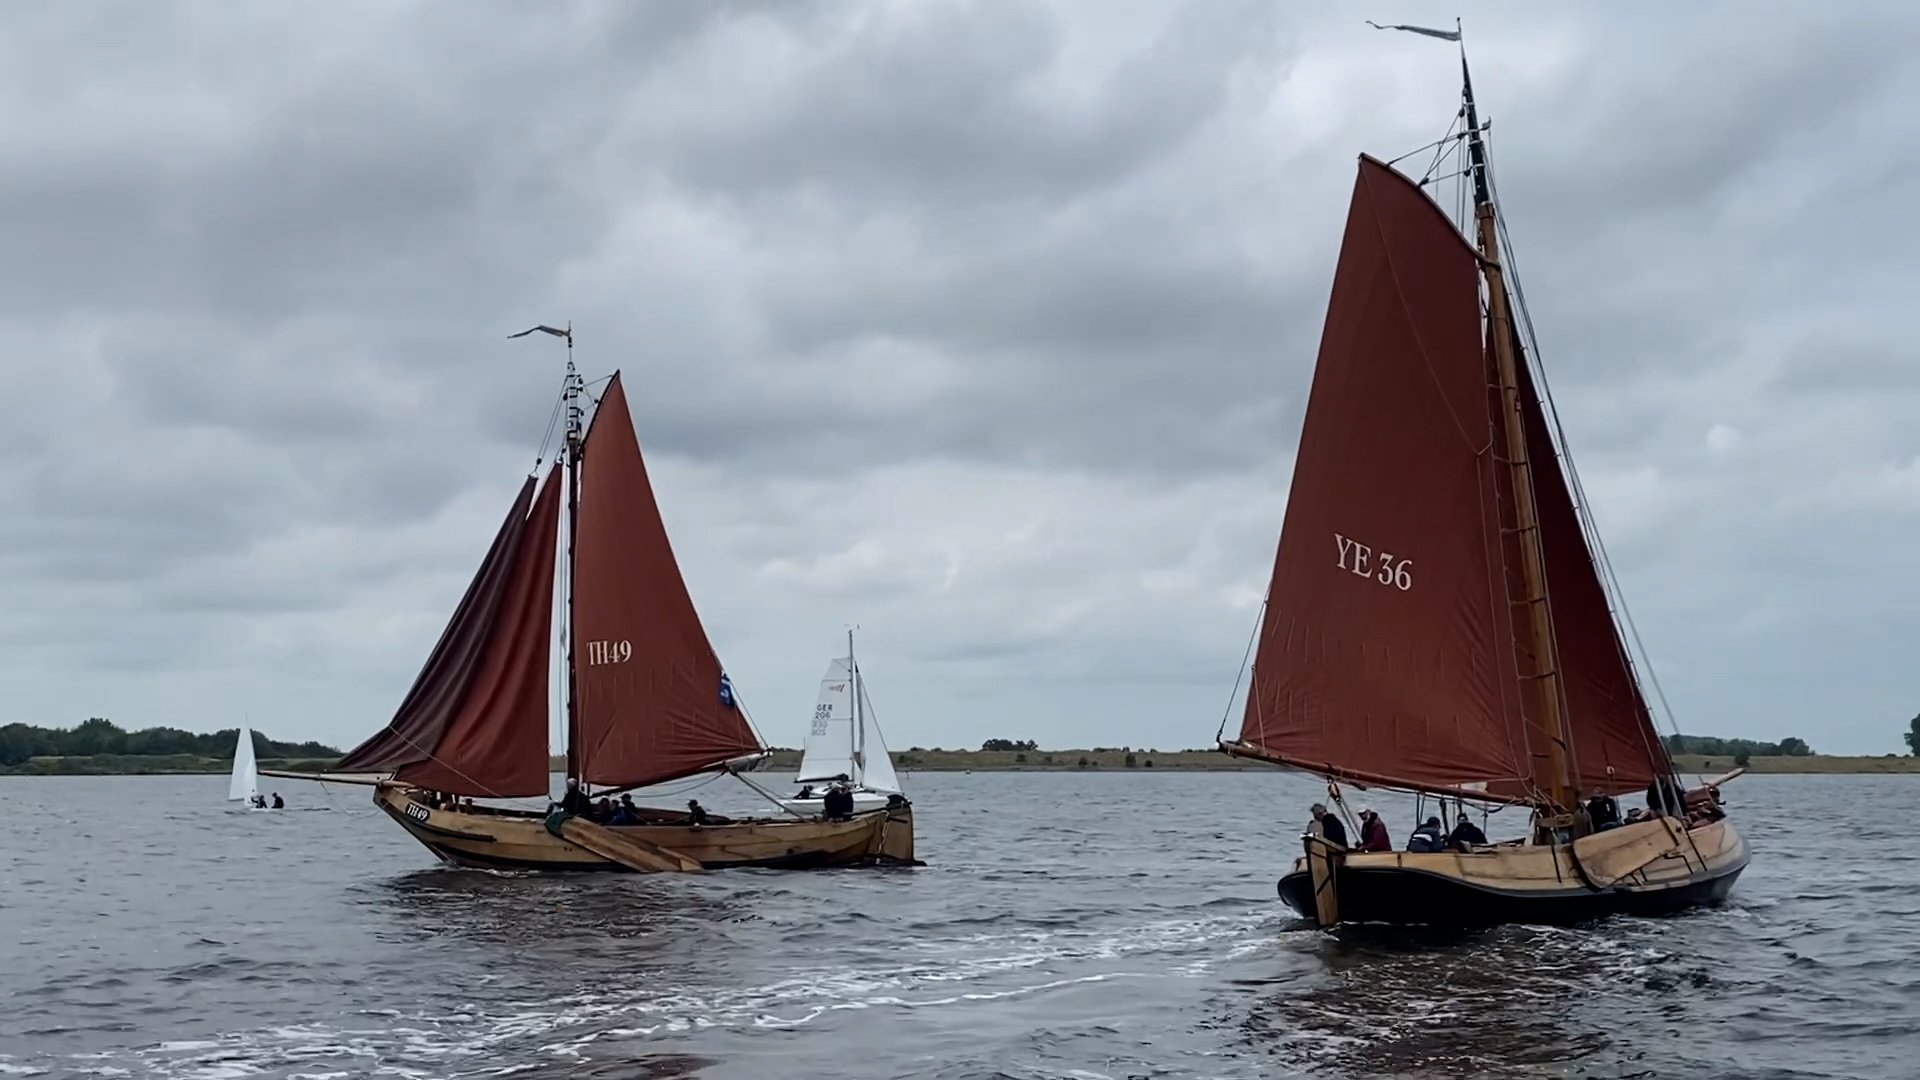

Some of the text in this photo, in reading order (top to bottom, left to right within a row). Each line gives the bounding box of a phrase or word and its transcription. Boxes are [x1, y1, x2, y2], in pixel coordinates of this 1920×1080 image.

[1334, 533, 1413, 591] YE 36
[586, 639, 632, 666] TH49
